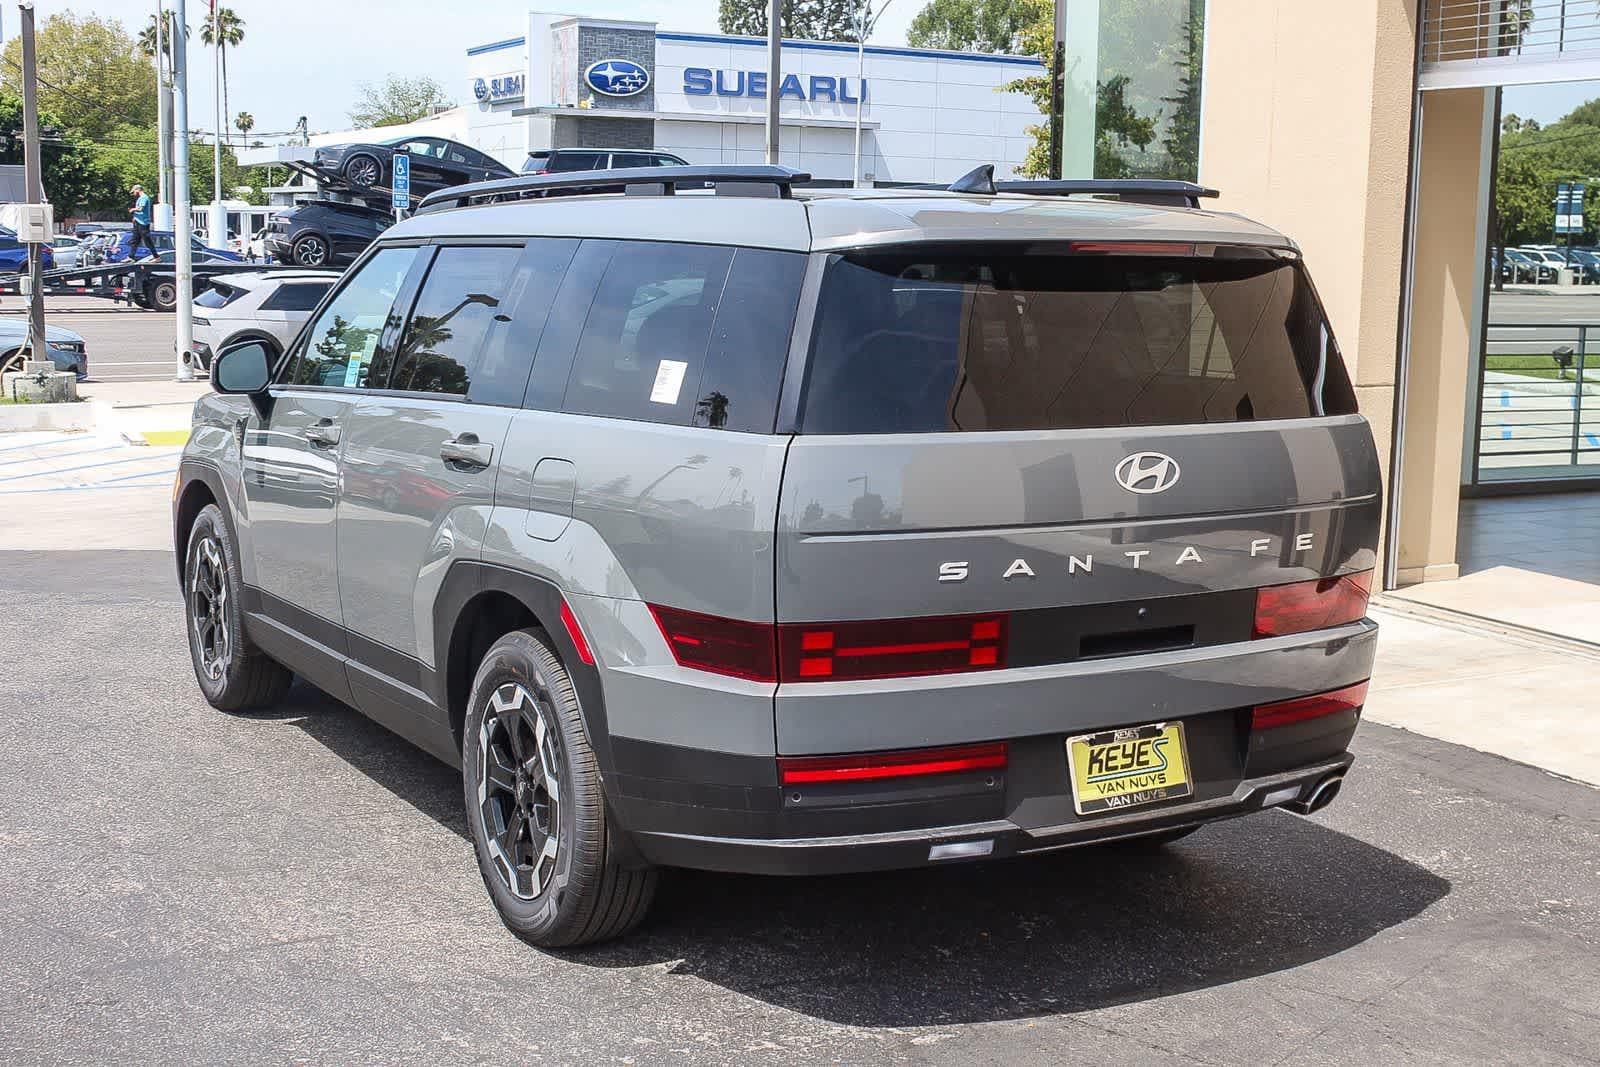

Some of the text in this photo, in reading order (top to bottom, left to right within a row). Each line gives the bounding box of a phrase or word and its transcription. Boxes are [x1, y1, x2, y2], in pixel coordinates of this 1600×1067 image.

[490, 74, 526, 97] SUBA
[683, 67, 867, 105] SUBARU
[938, 532, 1313, 581] SANTA FE
[1088, 738, 1168, 775] KEYES
[1096, 773, 1167, 794] VAN NUYS
[1105, 788, 1167, 808] VAN NUYS
